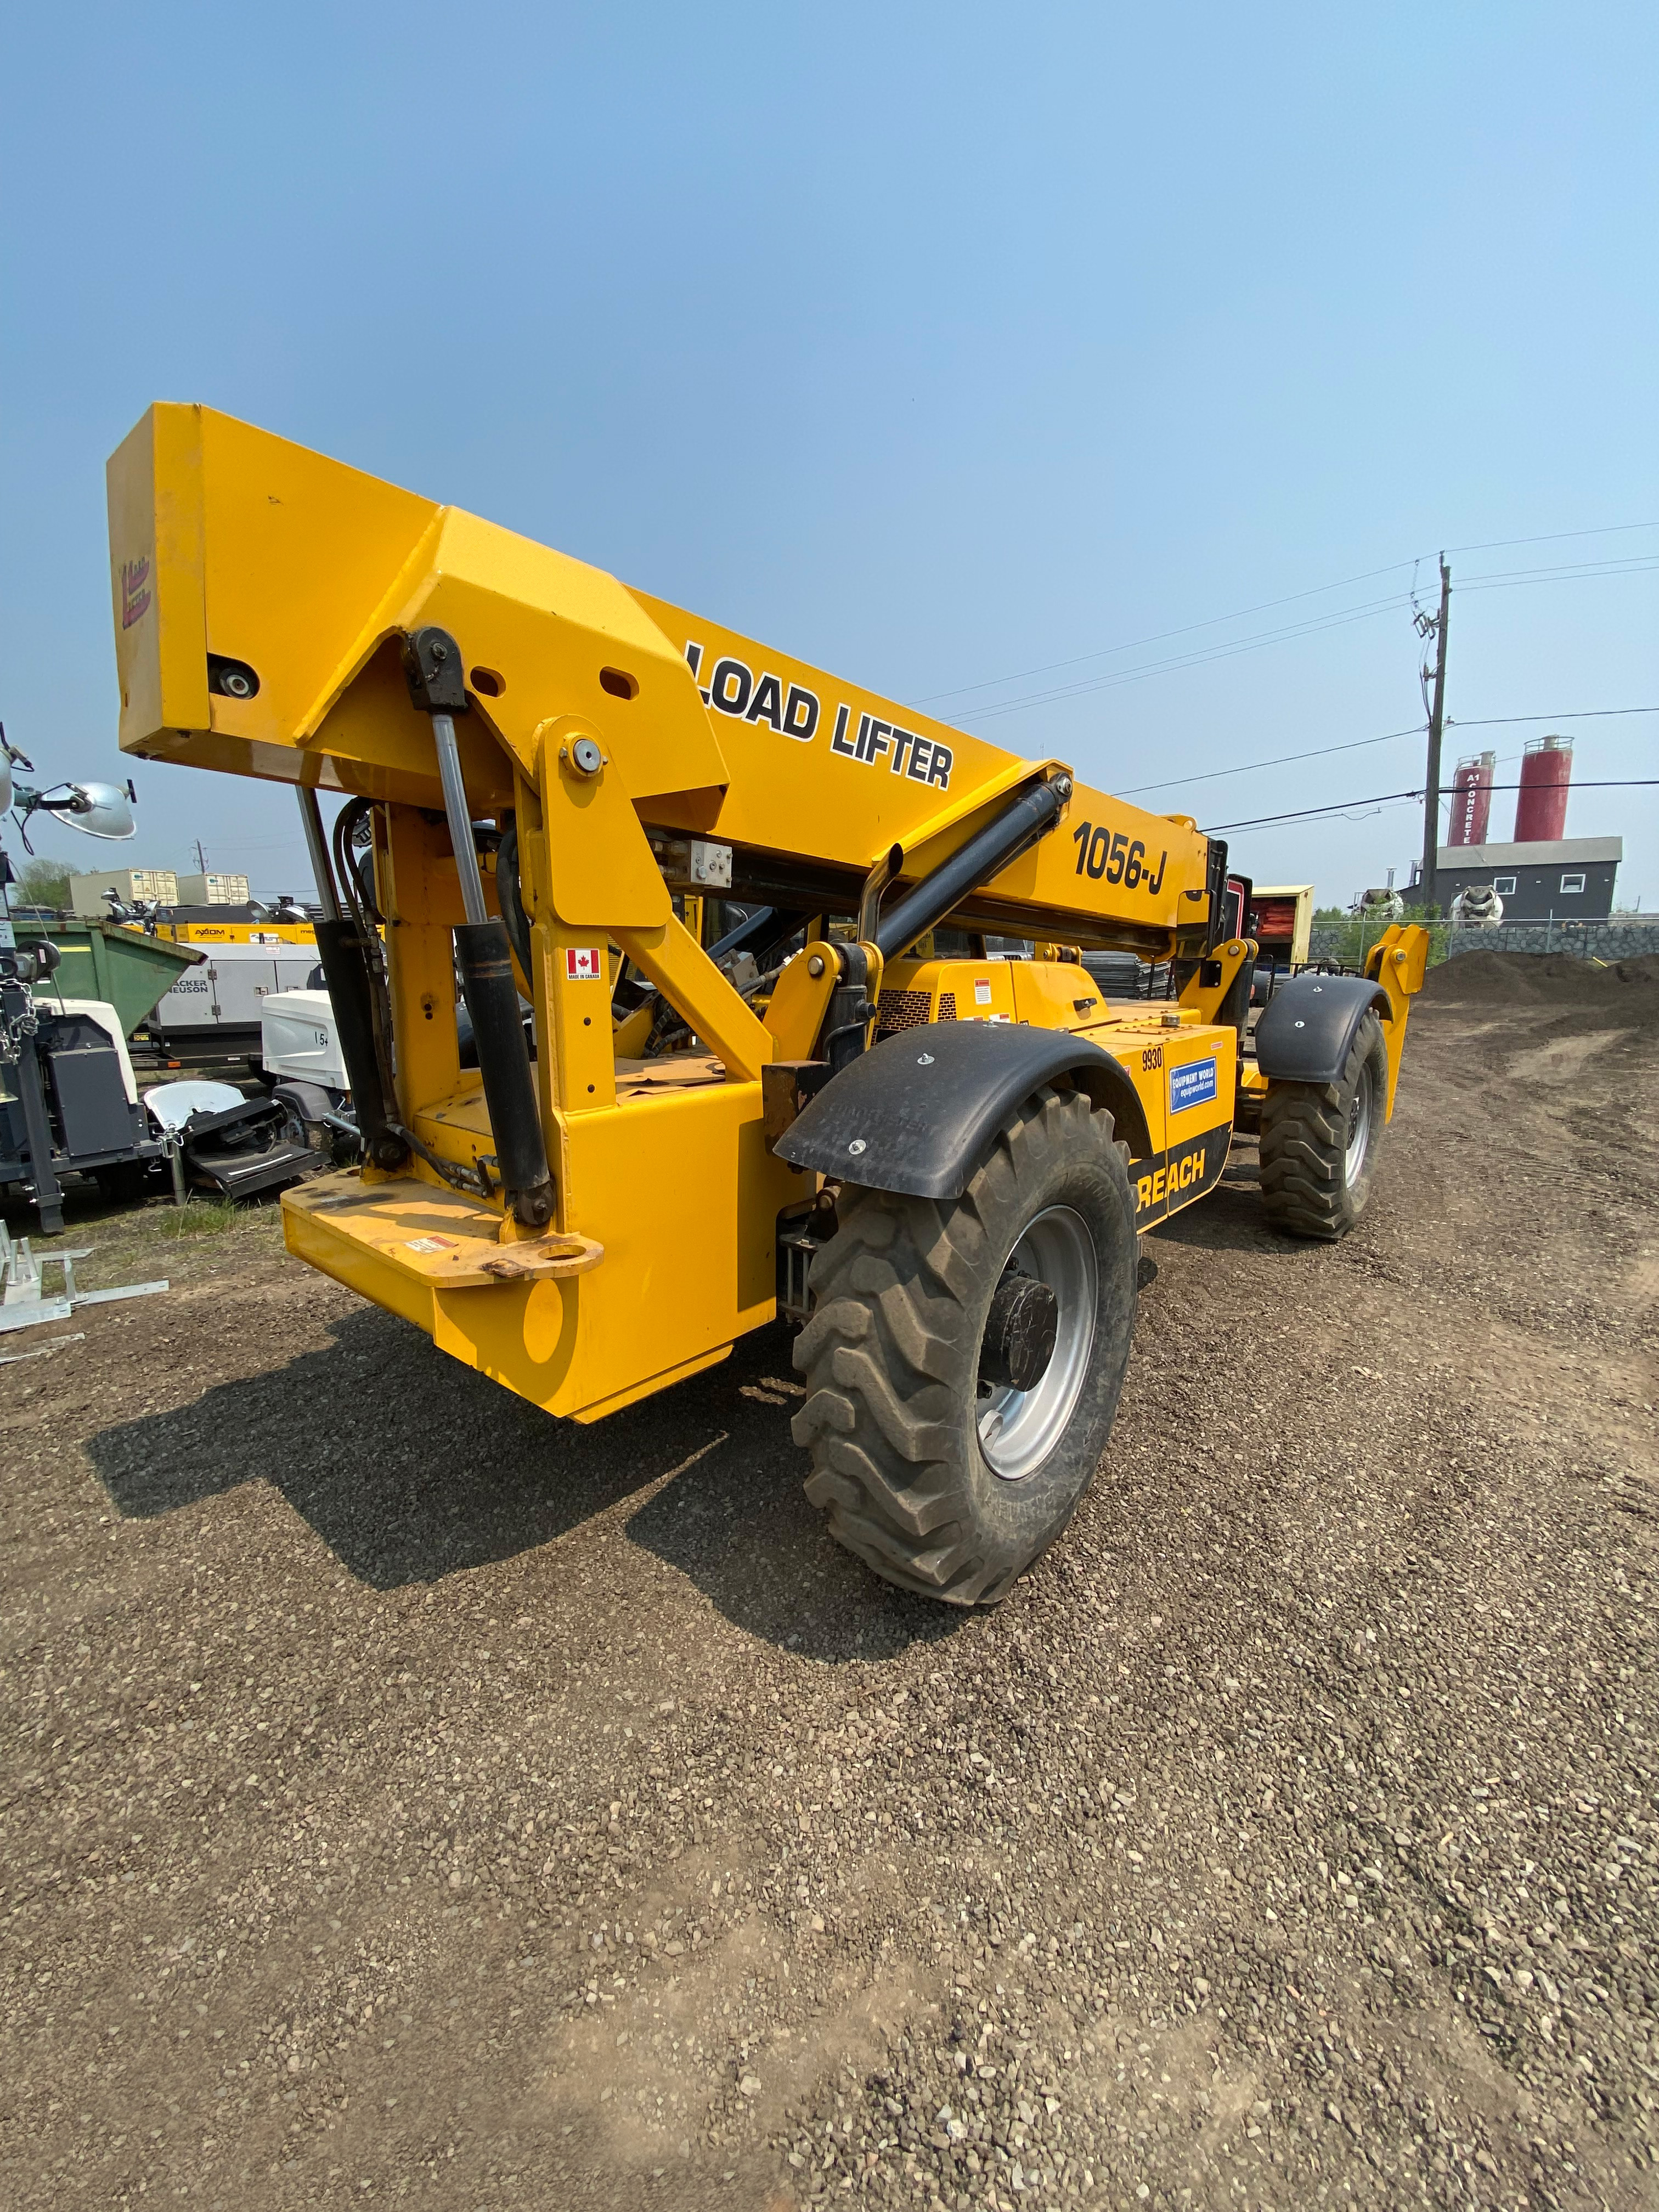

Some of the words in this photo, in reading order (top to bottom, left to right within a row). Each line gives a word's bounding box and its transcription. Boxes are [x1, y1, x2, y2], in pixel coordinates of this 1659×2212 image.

[684, 640, 821, 743] LOAD
[830, 702, 953, 792] LIFTER
[1466, 774, 1480, 782] A1
[1463, 783, 1477, 844] CONCRETE
[1073, 821, 1167, 895] 1056-J
[1142, 1046, 1163, 1072] 9930
[1172, 1073, 1198, 1090] EQUIPMENT
[1180, 1079, 1214, 1099] equipworld.com
[1136, 1148, 1206, 1213] REACH
